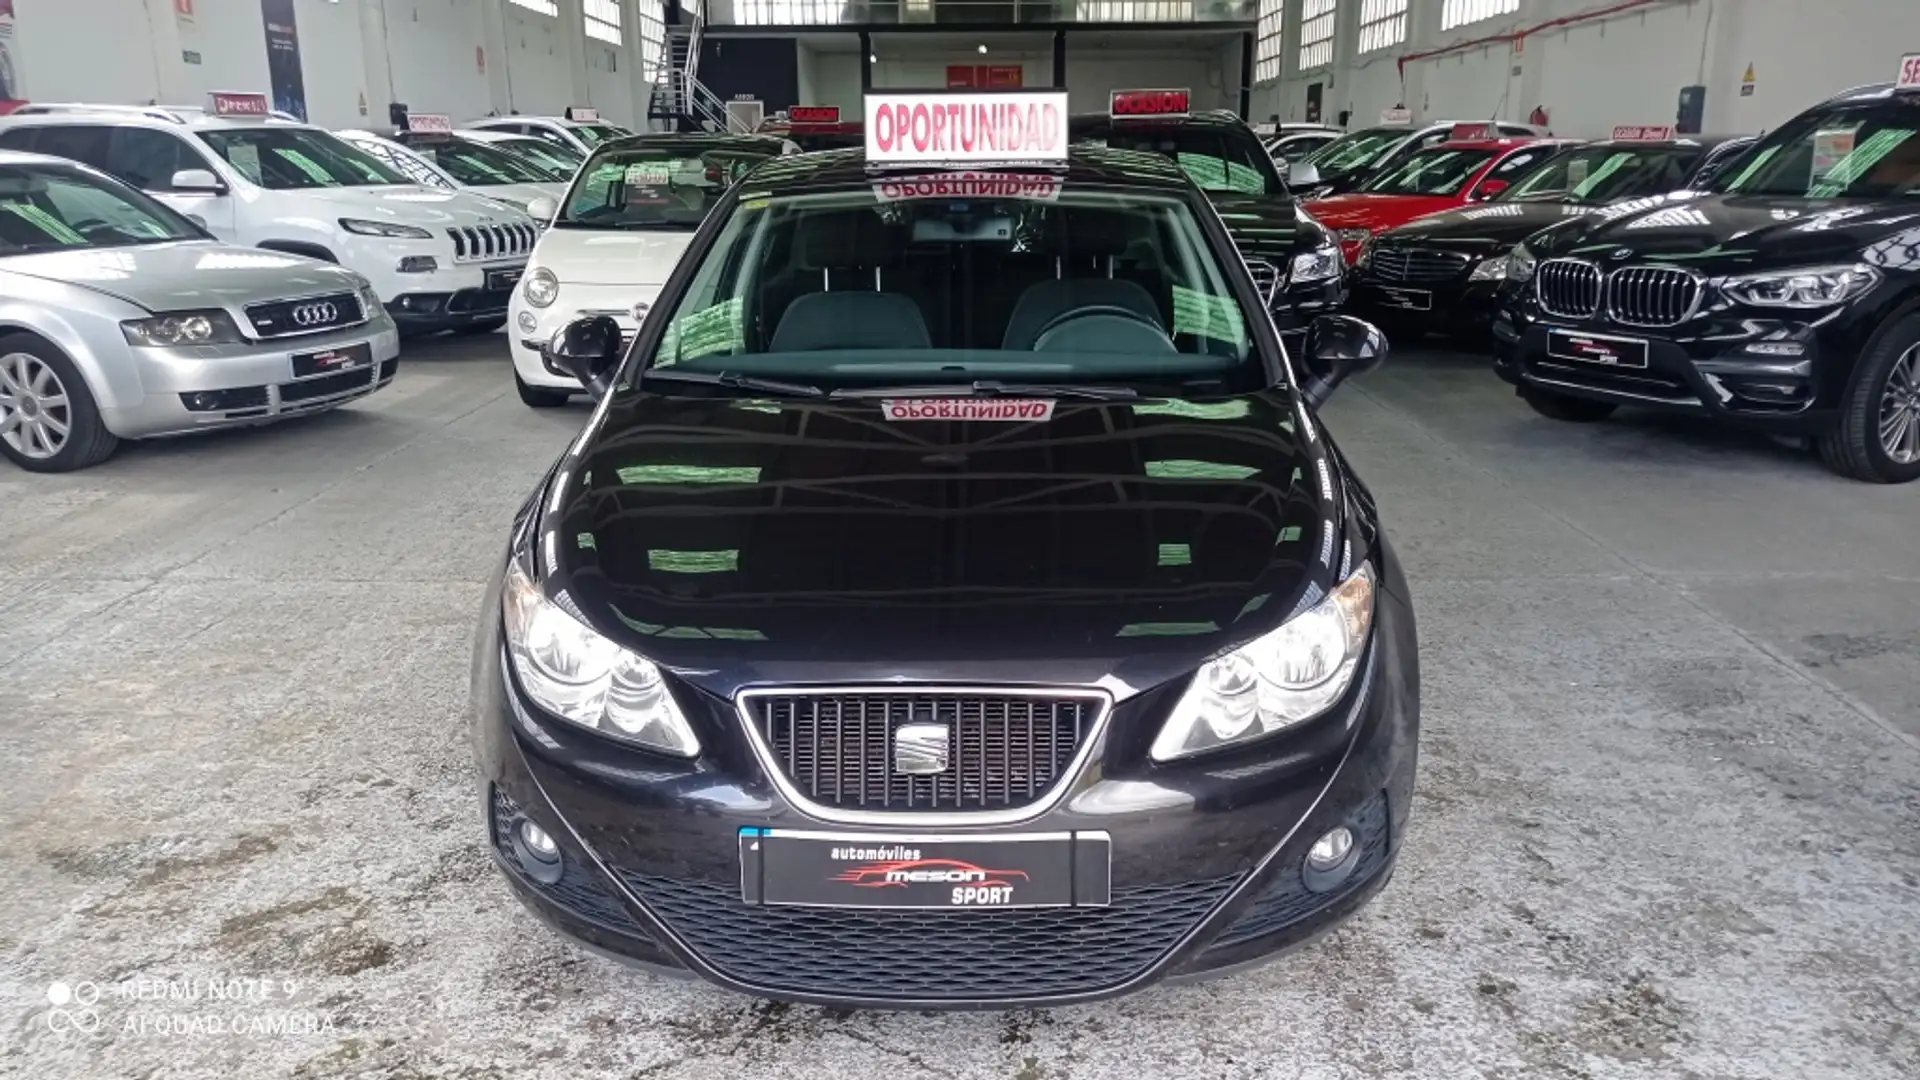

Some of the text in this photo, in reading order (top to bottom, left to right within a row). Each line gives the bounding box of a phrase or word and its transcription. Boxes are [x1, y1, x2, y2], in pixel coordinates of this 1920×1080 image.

[1115, 92, 1186, 112] OCASION
[875, 102, 1060, 152] OPORTUNIDAD
[831, 846, 921, 861] automóviles
[951, 886, 1014, 905] SPORT
